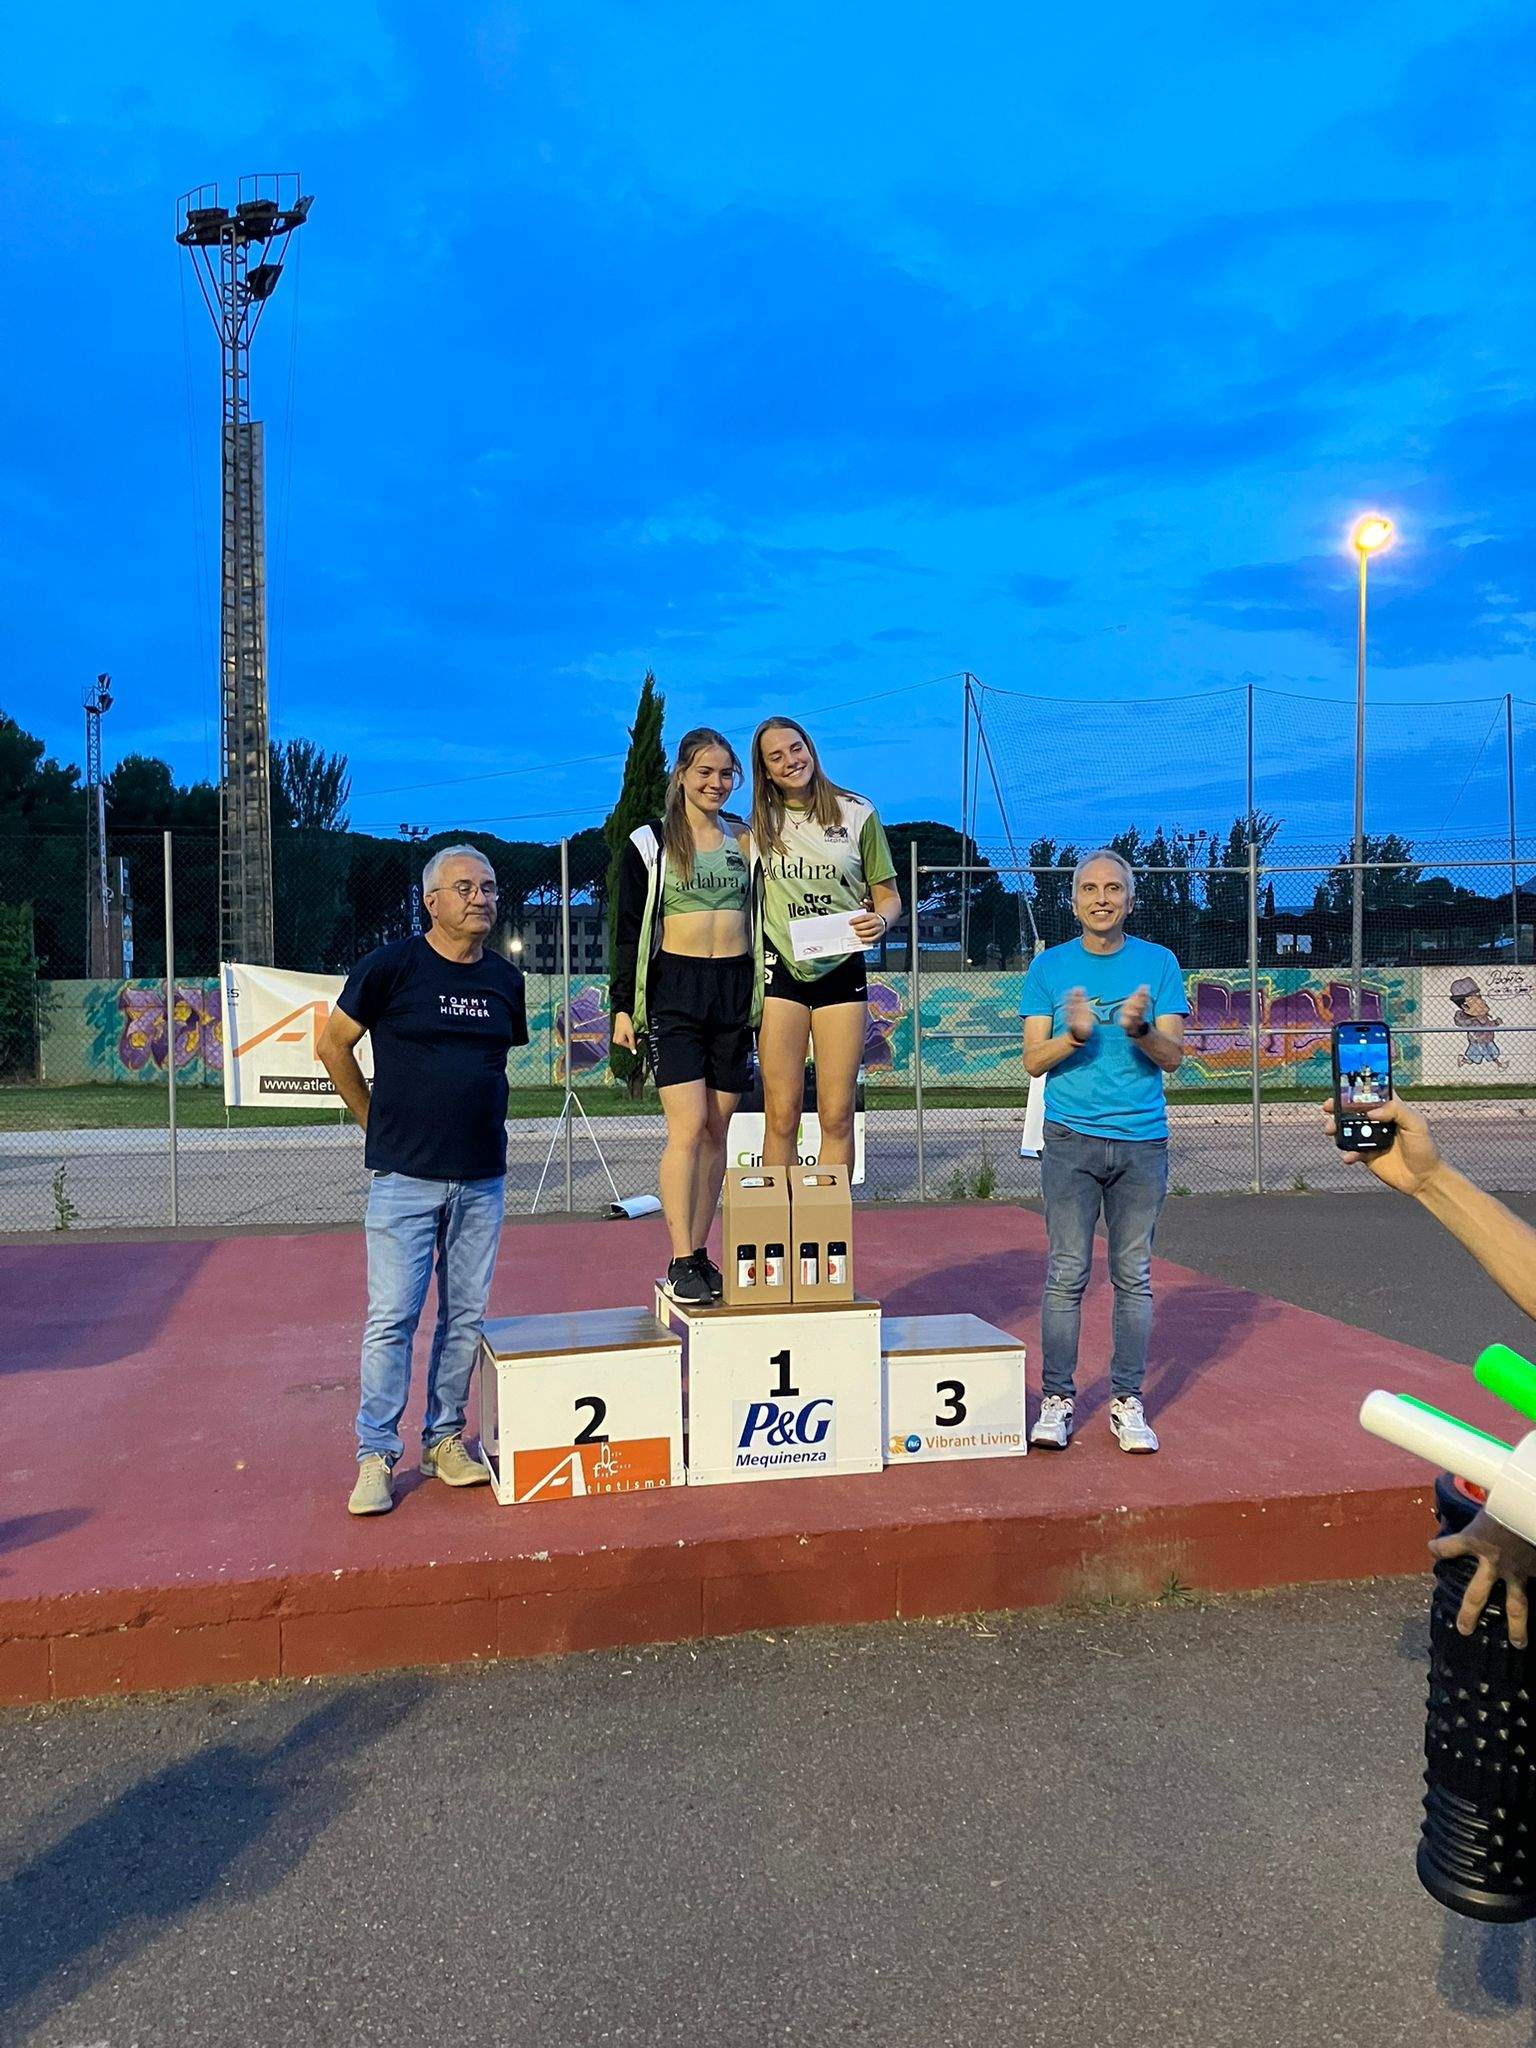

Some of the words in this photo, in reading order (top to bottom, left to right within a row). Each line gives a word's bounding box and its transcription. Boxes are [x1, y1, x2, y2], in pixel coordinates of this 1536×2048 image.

[438, 995, 487, 1007] TOMMY
[440, 1006, 490, 1018] HILFIGER
[769, 1349, 800, 1398] 1
[935, 1379, 967, 1427] 3
[574, 1396, 609, 1445] 2
[736, 1398, 834, 1449] P&G
[925, 1435, 977, 1449] Vibrant
[980, 1431, 1020, 1446] Living
[735, 1450, 827, 1468] Mequinenza
